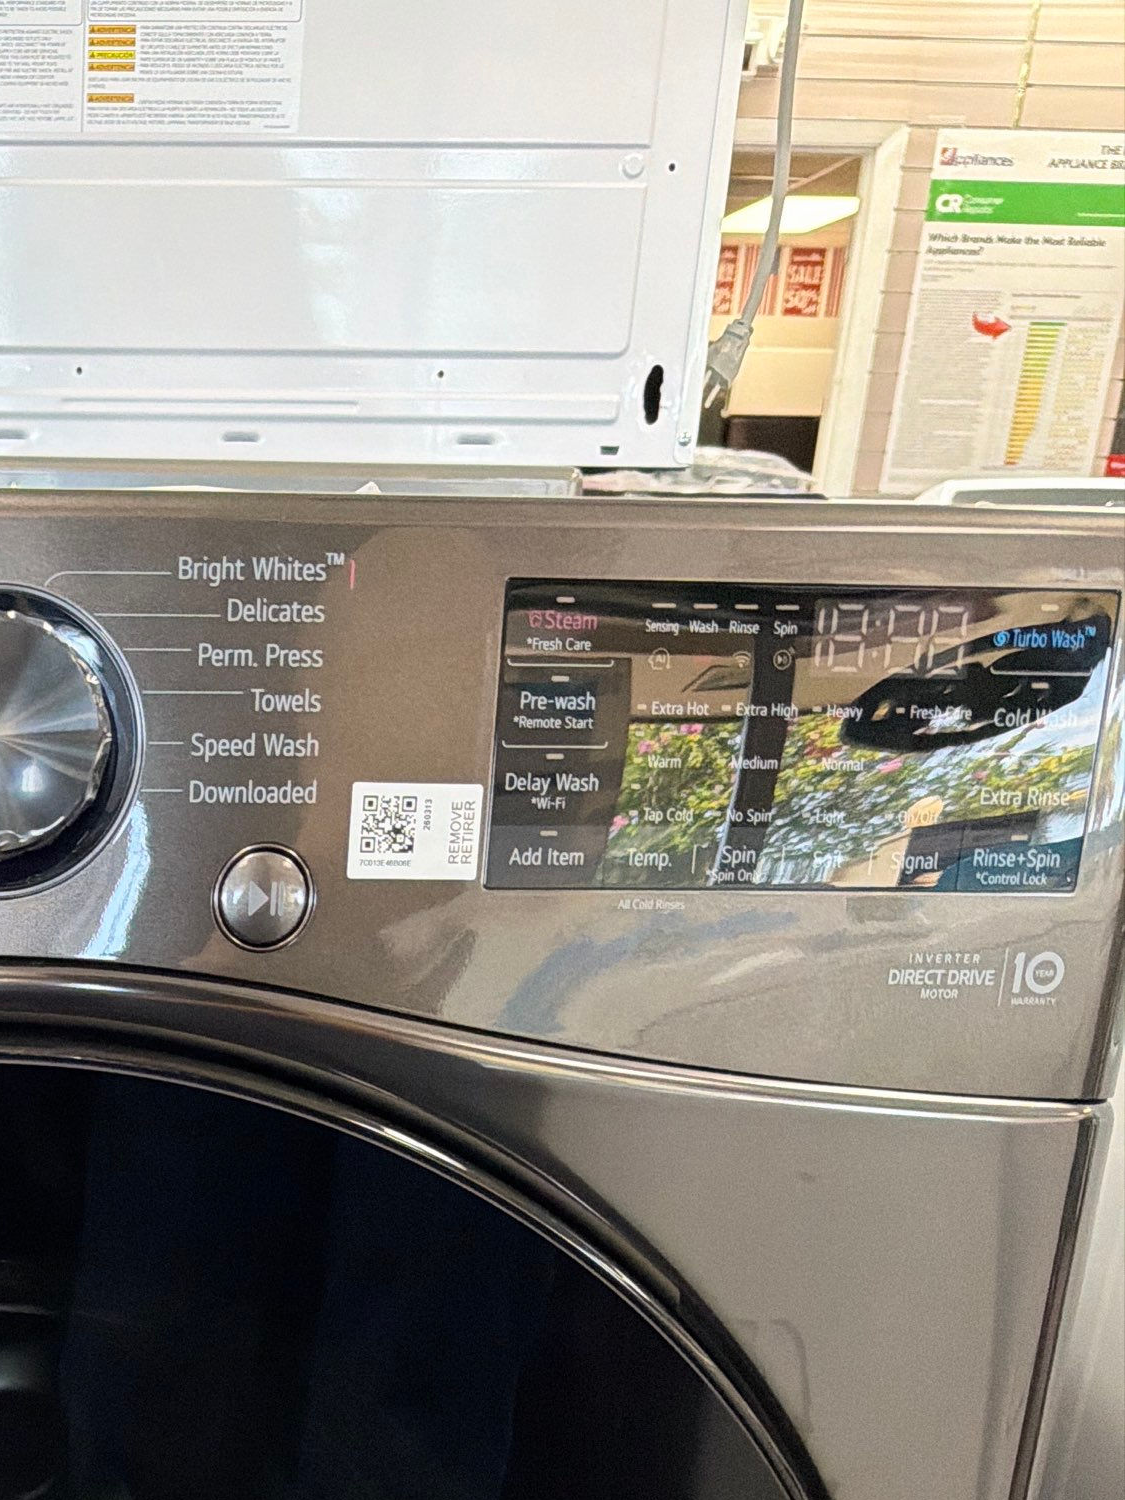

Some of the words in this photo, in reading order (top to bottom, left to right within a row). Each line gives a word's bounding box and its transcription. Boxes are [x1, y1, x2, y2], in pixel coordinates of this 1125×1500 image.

[1047, 158, 1108, 169] APPLIANCE
[936, 193, 963, 213] CR
[928, 233, 959, 242] Which
[1025, 236, 1039, 245] the
[178, 556, 245, 586] Bright
[227, 598, 325, 623] Delicates
[545, 611, 598, 629] Steam
[645, 619, 679, 636] Sensing
[689, 620, 718, 633] Wash
[729, 621, 760, 634] Rinse
[774, 621, 798, 637] Spin
[566, 638, 591, 650] Care
[1013, 629, 1047, 648] Turbo
[198, 643, 258, 668] Perm.
[266, 643, 324, 668] Press
[251, 688, 322, 713] Towels
[520, 691, 596, 710] Pre-wash
[651, 702, 683, 715] Extra
[687, 702, 709, 716] Hot
[736, 702, 767, 716] Extra
[771, 703, 798, 720] High
[827, 706, 863, 721] Heavy
[910, 706, 941, 719] Fresh
[994, 708, 1031, 727] Cold
[565, 716, 593, 729] Start
[191, 733, 255, 762] Speed
[264, 734, 319, 757] Wash
[648, 755, 682, 768] Warm
[731, 755, 778, 769] Medium
[823, 758, 864, 771] Normal
[189, 780, 317, 804] Downloaded
[505, 772, 550, 796] Delay
[555, 773, 599, 791] Wash
[980, 787, 1022, 806] Extra
[1027, 787, 1069, 806] Rinse
[644, 808, 663, 824] Tap
[667, 808, 694, 822] Cold
[727, 809, 743, 822] No
[747, 809, 773, 825] Spin
[448, 801, 463, 864] REMOVE
[461, 801, 476, 864] RETIRER
[509, 847, 542, 865] Add
[547, 848, 584, 866] Item
[628, 849, 672, 871] Temp.
[722, 845, 756, 867] Spin
[891, 852, 939, 874] Signal
[973, 848, 1061, 872] Rinse+Spin
[1023, 873, 1047, 885] Lock
[618, 899, 631, 909] All
[632, 899, 654, 909] Cold
[909, 953, 980, 965] INVERTER
[888, 969, 947, 985] DIRECT
[947, 969, 996, 985] DRIVE
[1012, 951, 1065, 994] 10
[1034, 970, 1055, 978] YEAR
[921, 988, 959, 999] MOTOR
[1011, 998, 1057, 1006] WARRANTY
